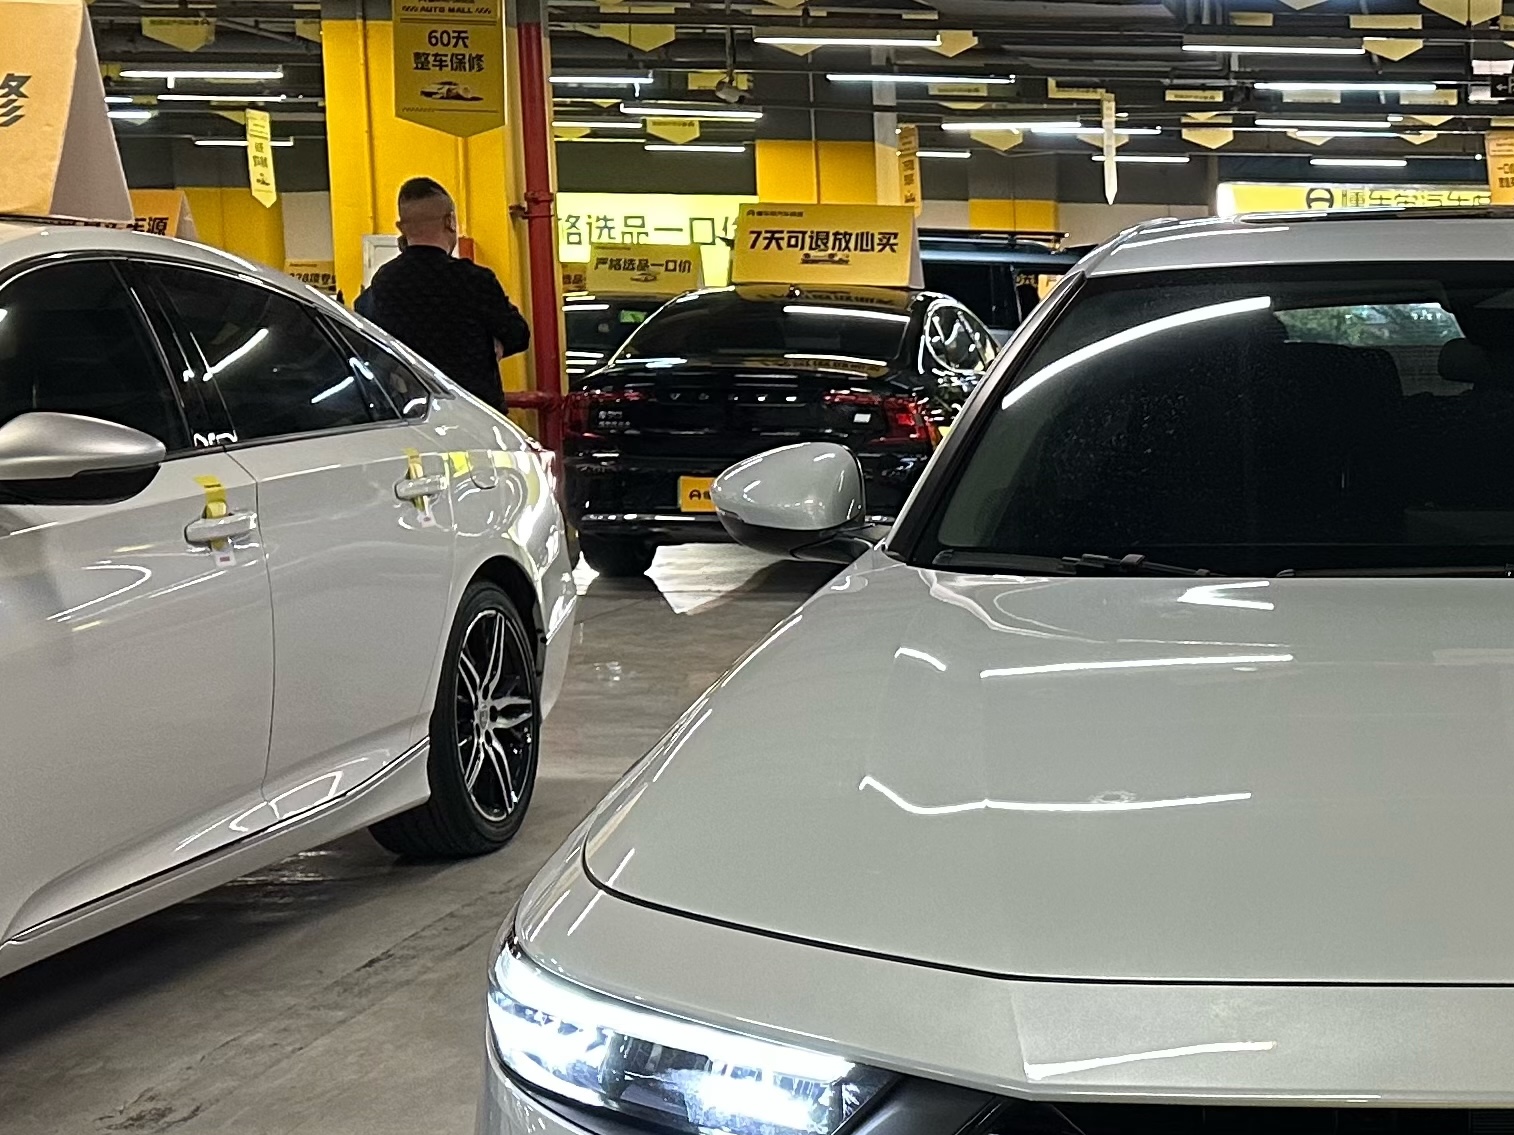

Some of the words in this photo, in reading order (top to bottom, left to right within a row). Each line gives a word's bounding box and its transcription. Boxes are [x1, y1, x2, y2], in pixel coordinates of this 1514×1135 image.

[427, 29, 470, 49] 60天
[412, 51, 485, 72] 整车保修
[748, 230, 899, 253] 7天可退放心买
[593, 256, 693, 274] 严格选品一口价
